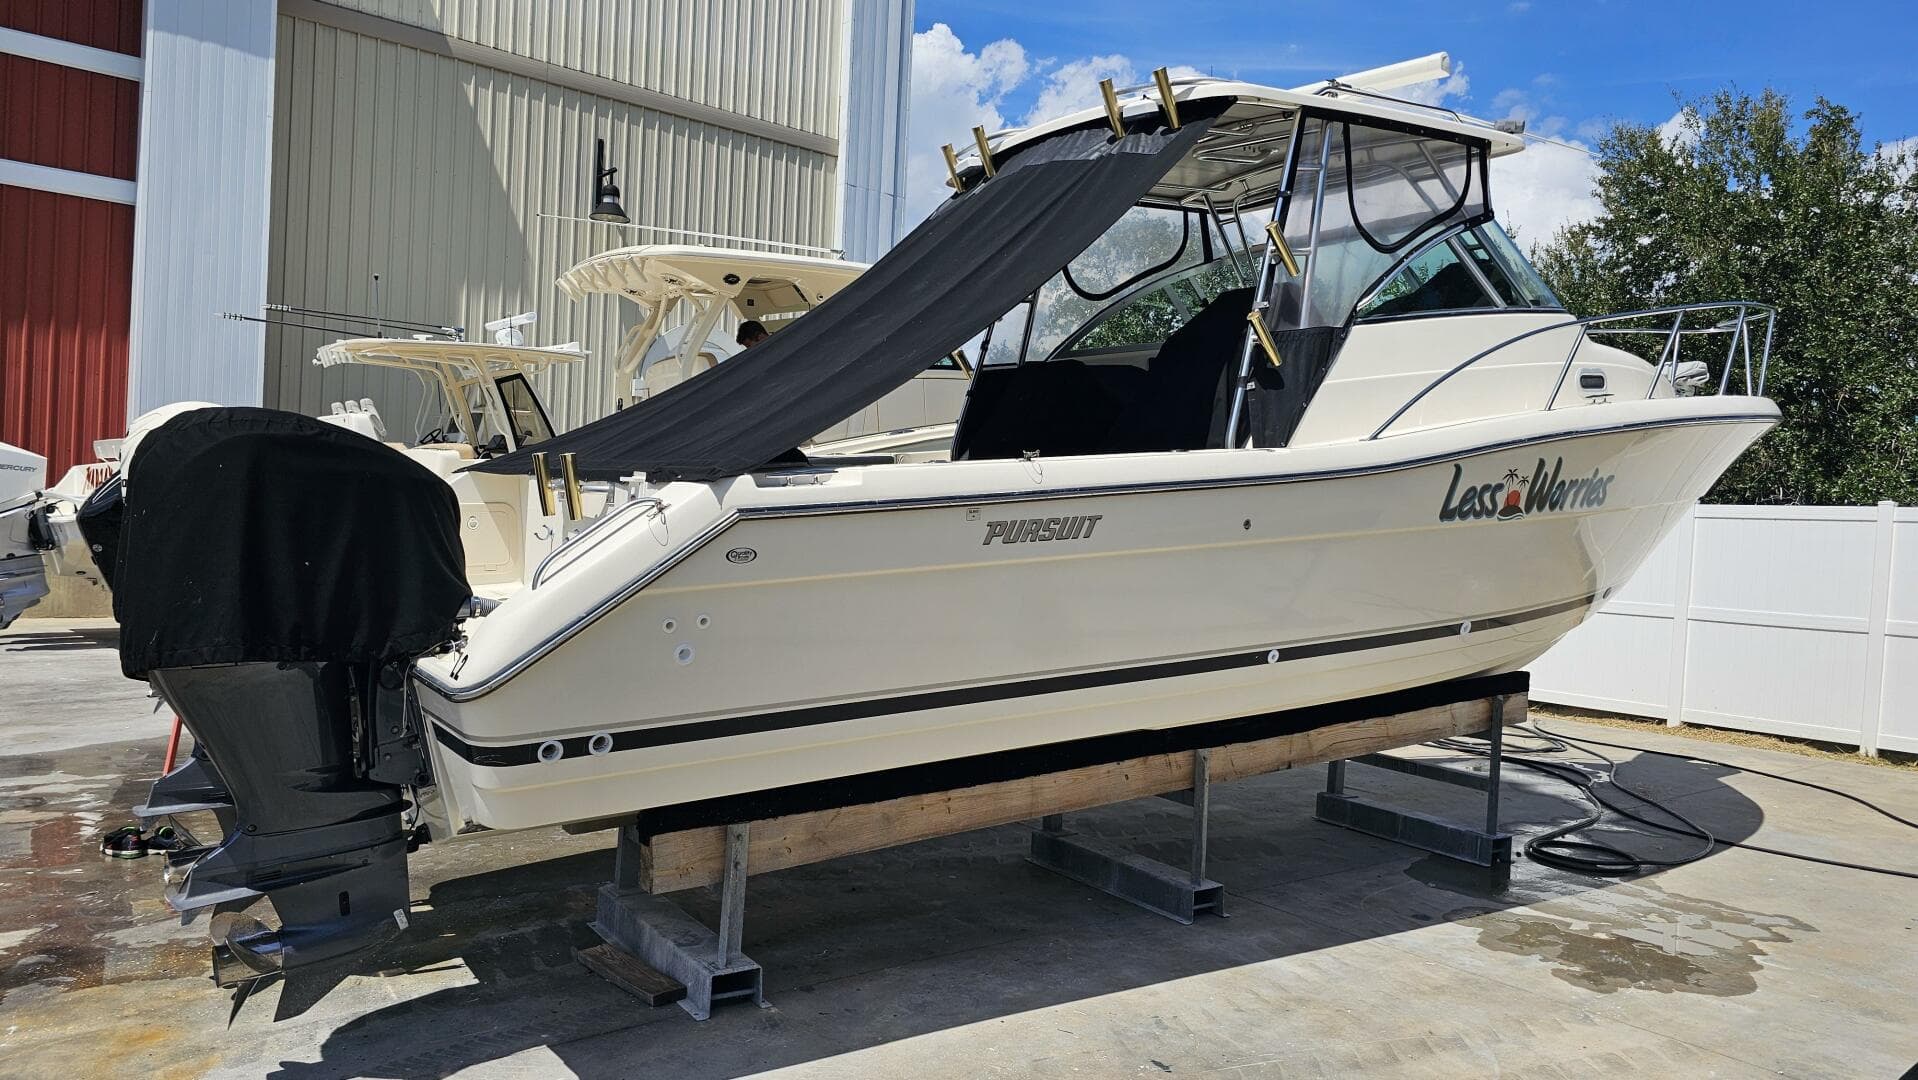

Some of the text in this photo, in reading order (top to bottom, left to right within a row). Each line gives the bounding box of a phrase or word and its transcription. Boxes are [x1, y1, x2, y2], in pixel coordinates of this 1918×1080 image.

[0, 463, 37, 472] ERCURY
[1439, 456, 1615, 523] Less Worries
[983, 515, 1103, 545] PURSUIT
